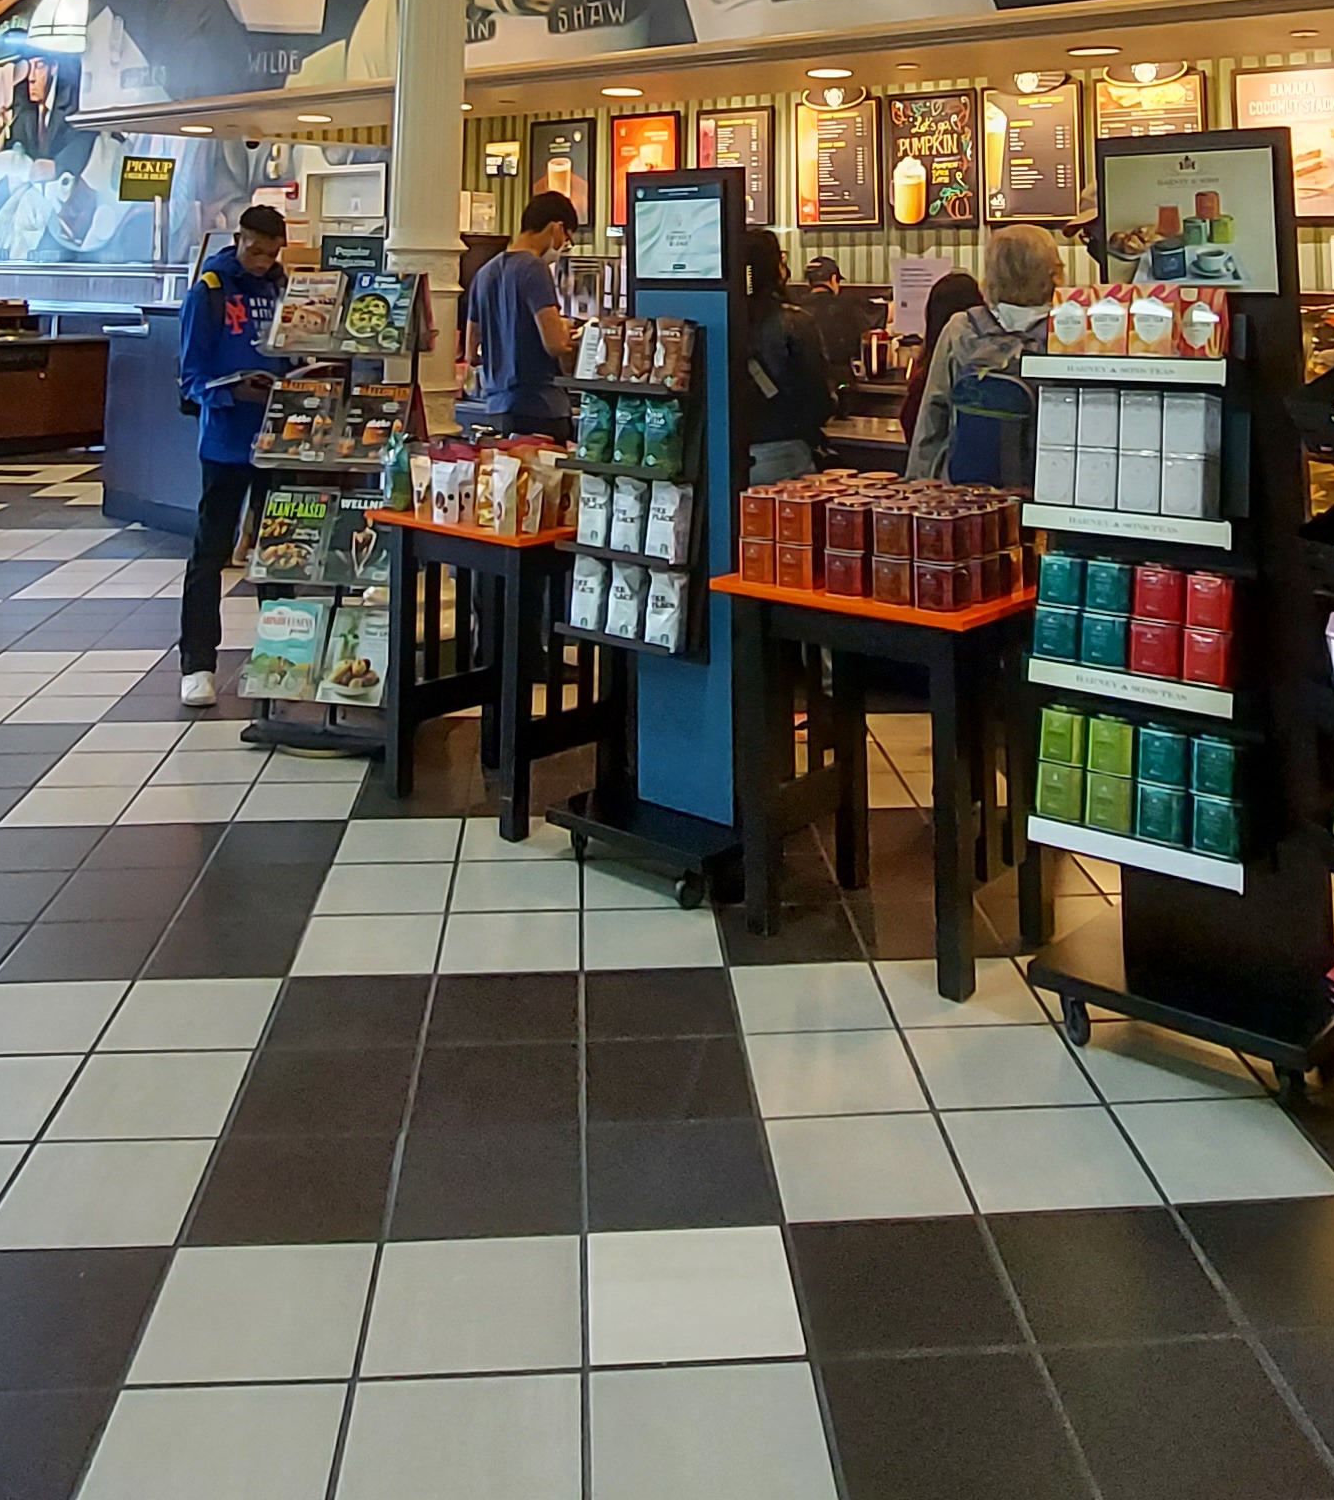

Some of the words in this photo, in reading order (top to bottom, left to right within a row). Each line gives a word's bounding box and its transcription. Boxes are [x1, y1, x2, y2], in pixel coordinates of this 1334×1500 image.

[248, 49, 300, 74] WILDE
[1269, 80, 1315, 97] BANANA
[1248, 98, 1300, 116] COCONUT
[897, 133, 959, 157] PUMPKIN
[125, 159, 155, 173] PICK
[156, 161, 173, 173] UP
[335, 246, 371, 257] Popular
[1067, 364, 1107, 374] HARNEY
[267, 501, 327, 519] PLANT-BASED
[1068, 516, 1111, 527] HARNEY
[1075, 674, 1118, 690] HARNEY
